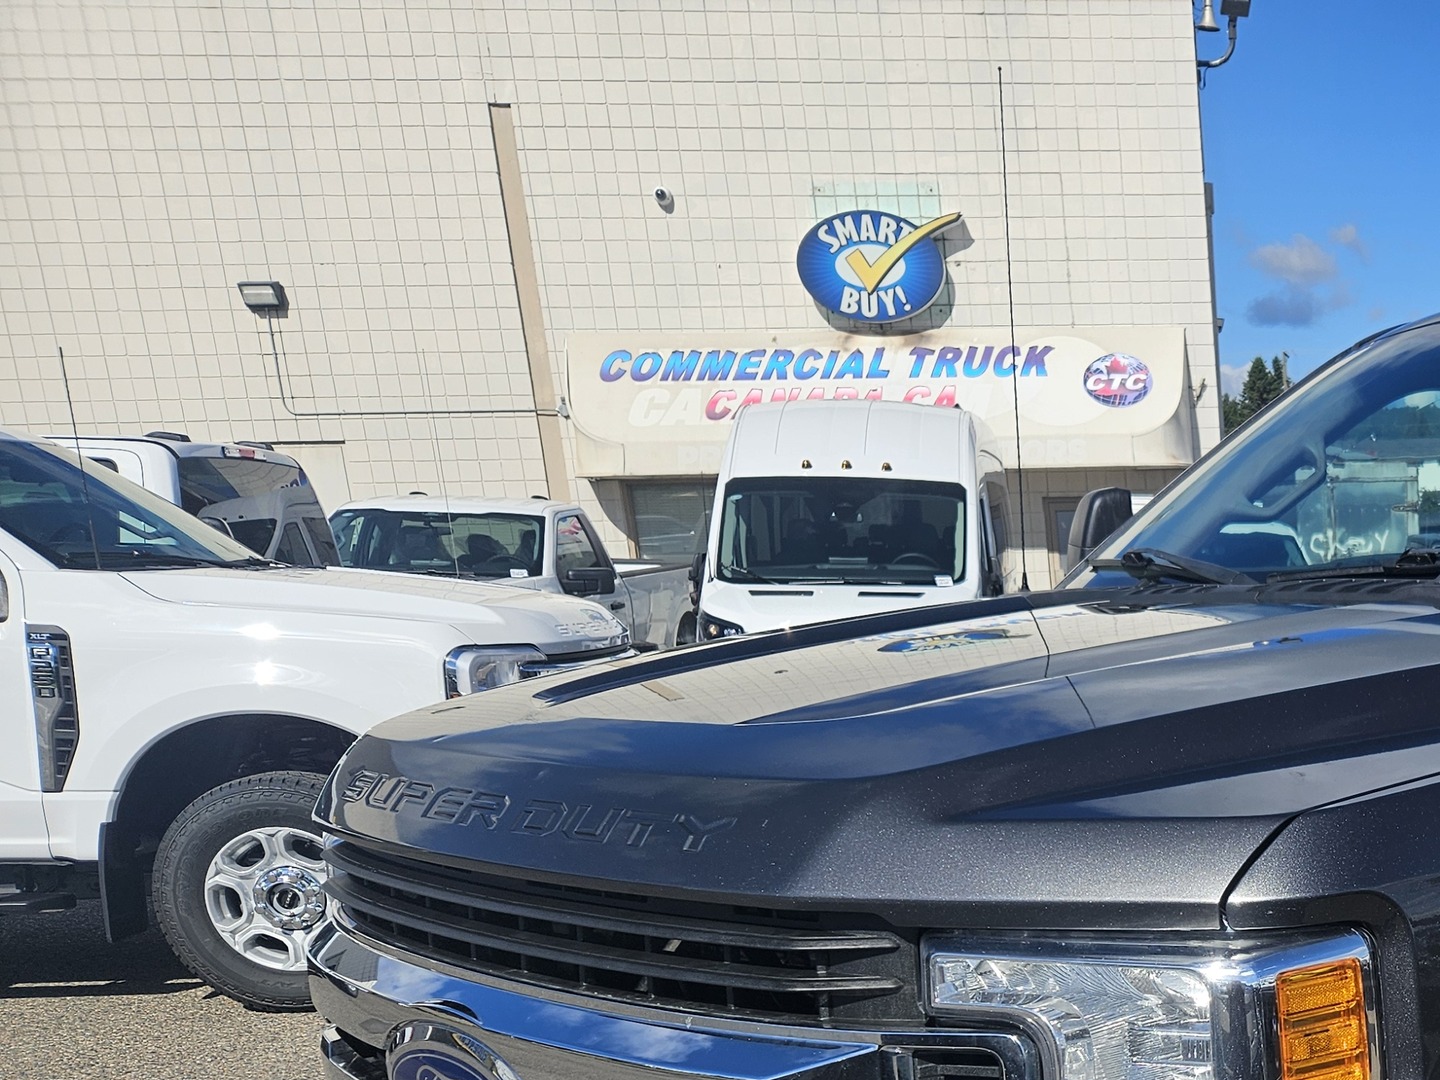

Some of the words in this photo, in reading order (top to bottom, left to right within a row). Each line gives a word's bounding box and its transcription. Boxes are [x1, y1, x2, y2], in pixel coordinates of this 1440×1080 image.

[817, 213, 917, 254] SMART
[839, 285, 912, 319] BUY!
[598, 346, 891, 383] COMMERCIAL
[908, 345, 1056, 380] TRUCK
[1086, 373, 1148, 392] CTC
[340, 769, 512, 830] SUPER
[511, 799, 738, 853] DUTY
